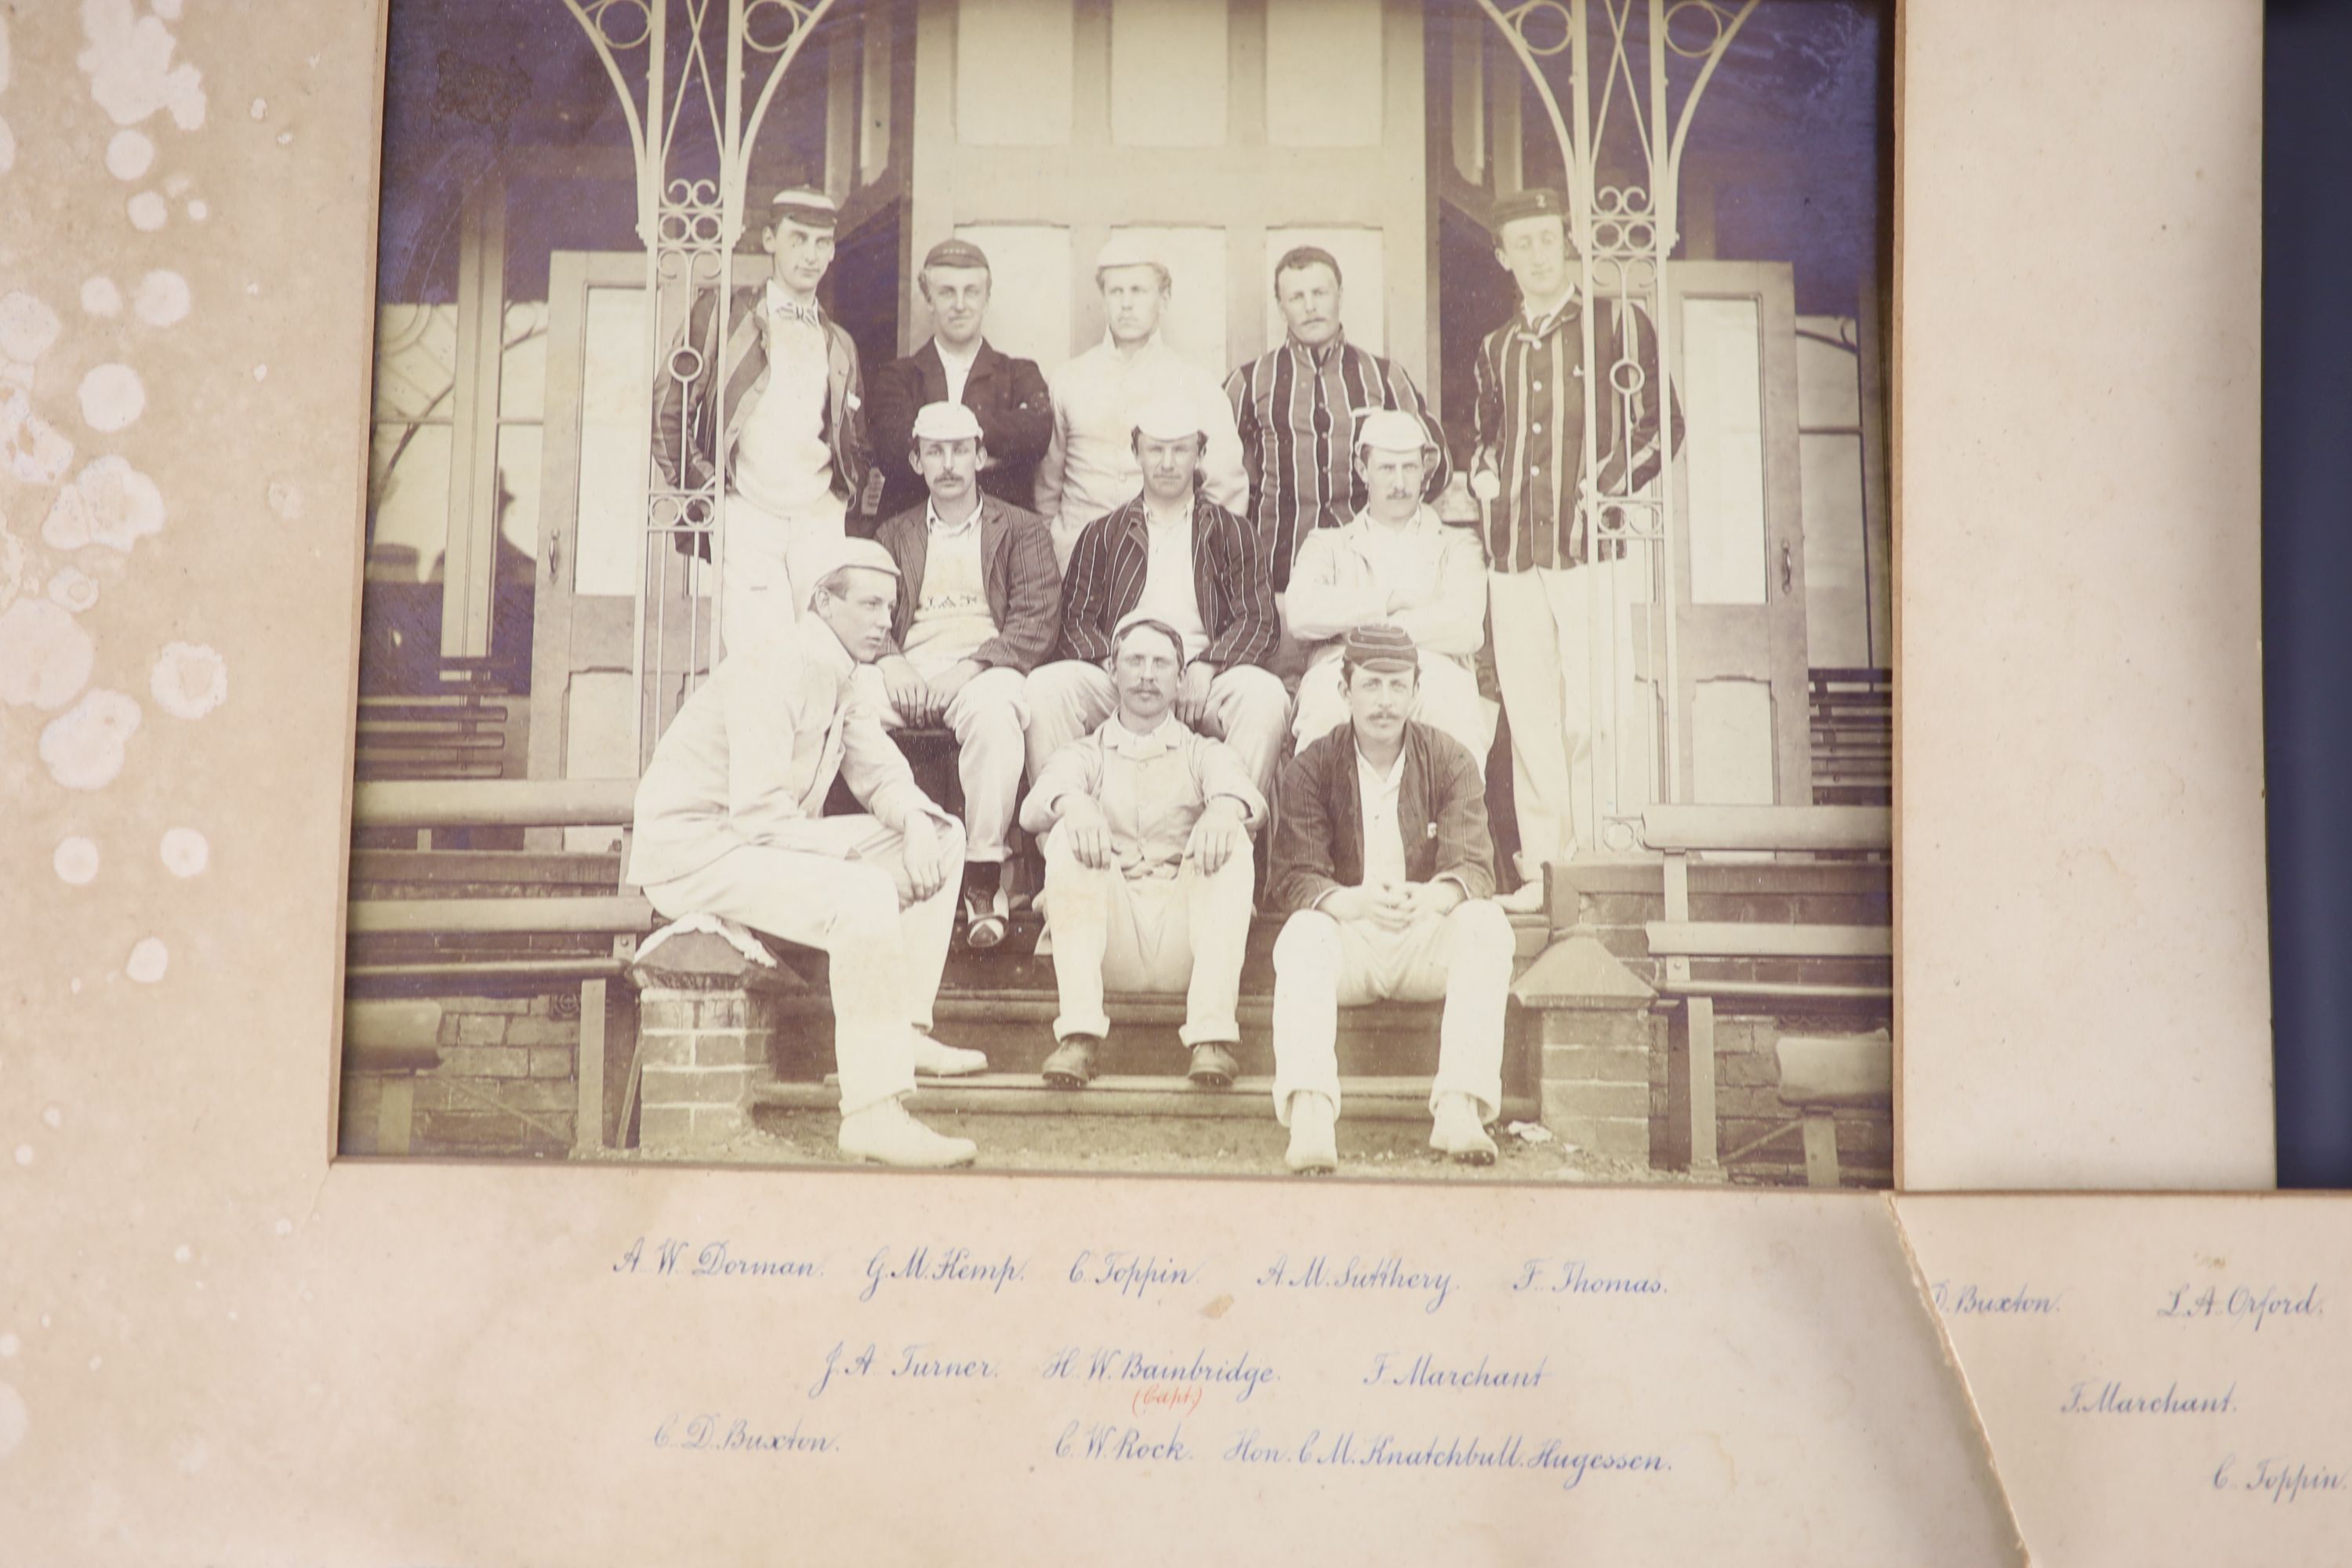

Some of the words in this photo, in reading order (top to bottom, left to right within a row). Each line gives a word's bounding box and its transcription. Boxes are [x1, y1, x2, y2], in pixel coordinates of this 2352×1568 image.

[691, 1240, 824, 1277] Dorman.
[932, 1247, 1025, 1294] Kemp.
[1094, 1250, 1201, 1298] Toppin.
[1552, 1259, 1668, 1294] Thomas.
[1955, 1282, 2063, 1315] Buxton.
[2227, 1283, 2324, 1332] Orford.
[891, 1343, 999, 1378] Turner.
[1121, 1348, 1282, 1403] Bainbridge.
[1392, 1354, 1552, 1388] Marchant
[2082, 1381, 2238, 1414] Marchant.
[722, 1417, 841, 1453] Buxton.
[1115, 1421, 1193, 1462] Rock.
[1223, 1428, 1291, 1464] Hon.
[1525, 1438, 1674, 1490] Hugessen.
